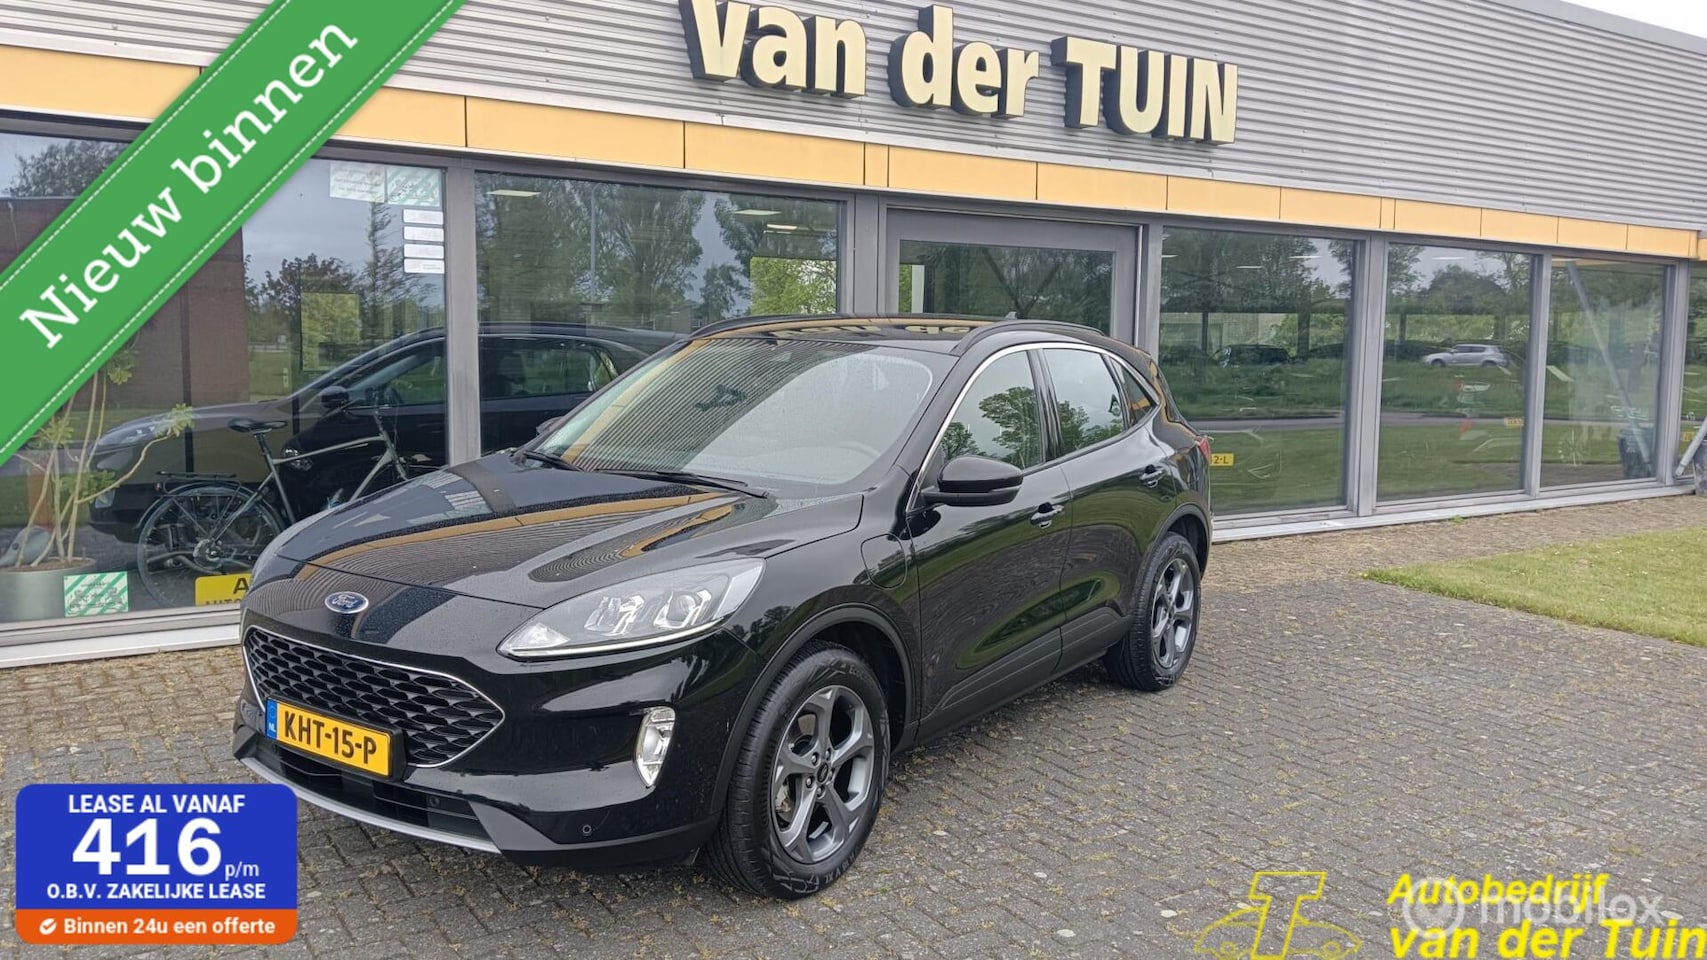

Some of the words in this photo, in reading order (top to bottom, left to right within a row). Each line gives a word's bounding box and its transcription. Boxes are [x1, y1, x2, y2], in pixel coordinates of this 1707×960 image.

[685, 0, 866, 98] van
[893, 4, 1040, 119] der
[1056, 36, 1238, 145] TUIN
[268, 722, 277, 732] NL
[284, 710, 377, 765] KHT-15-P
